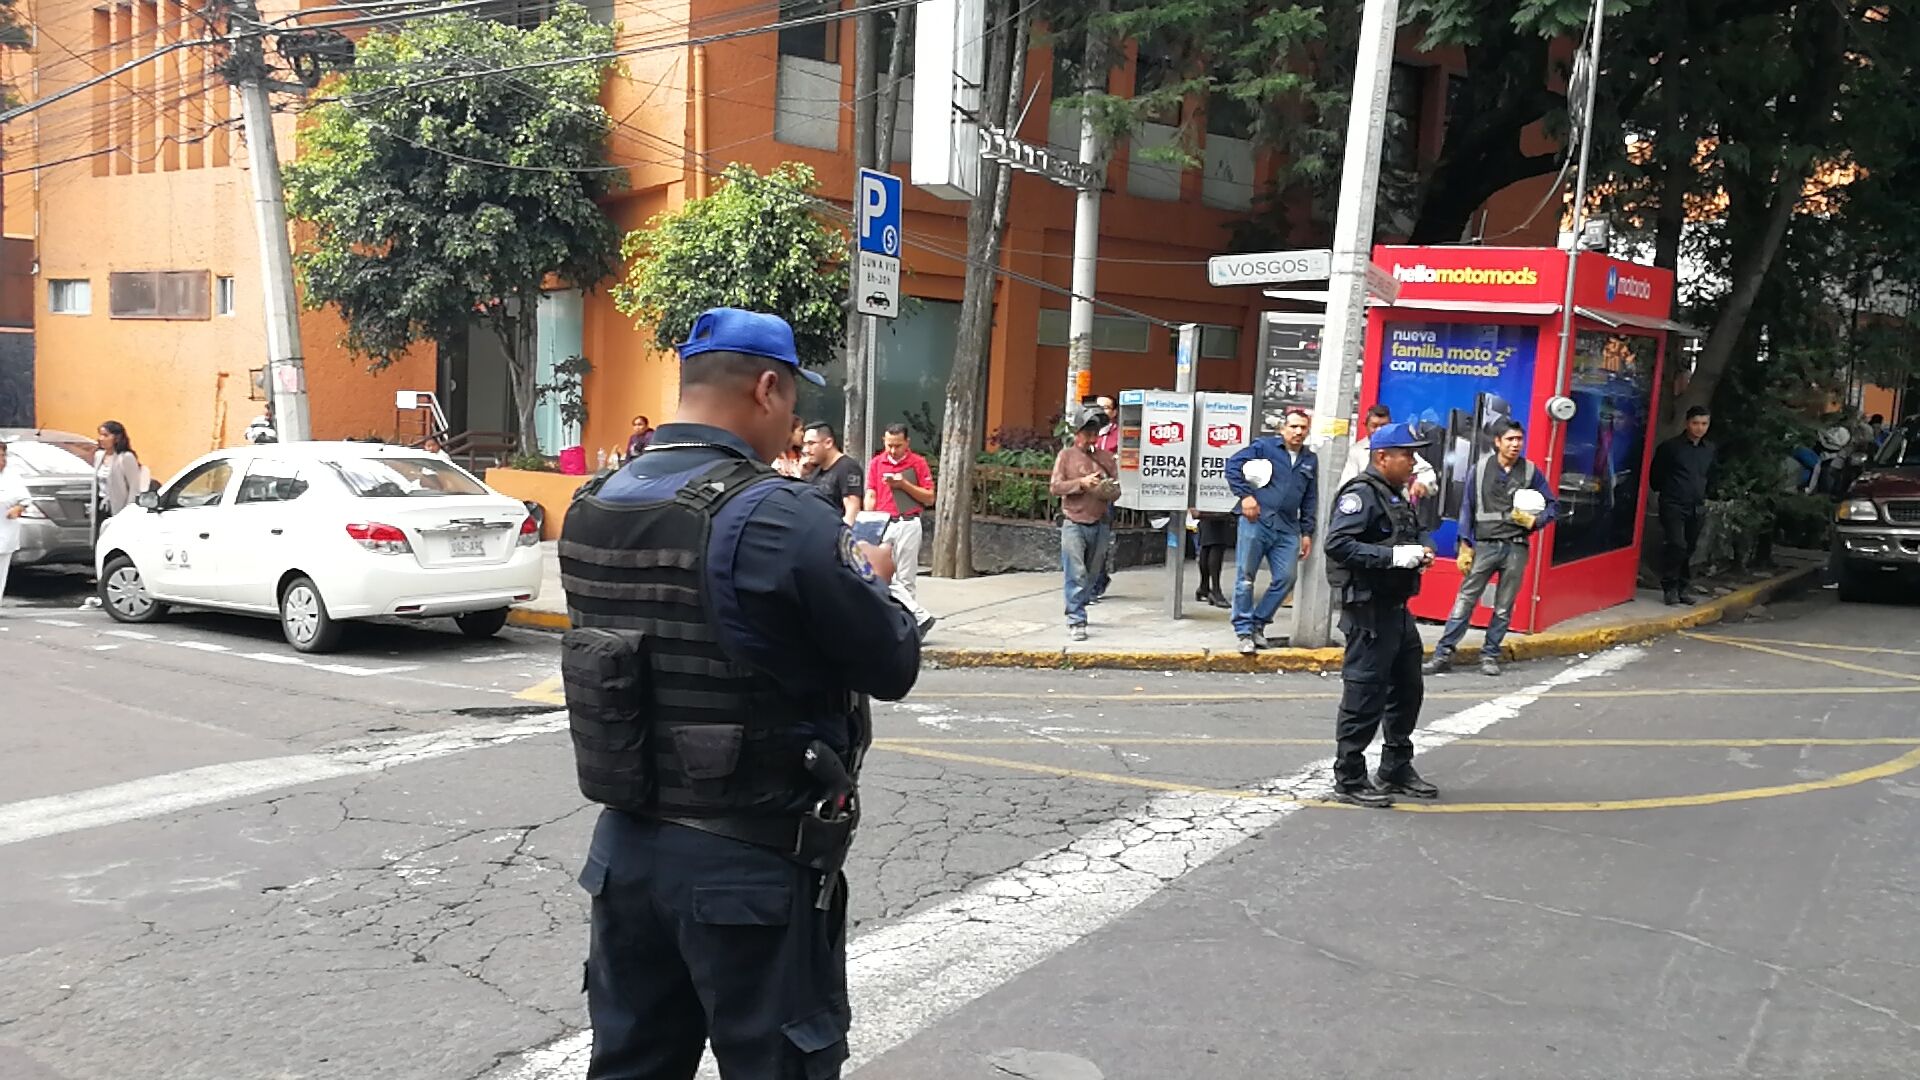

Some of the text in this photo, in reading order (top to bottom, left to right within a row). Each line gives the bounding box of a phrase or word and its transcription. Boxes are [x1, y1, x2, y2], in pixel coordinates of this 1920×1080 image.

[862, 176, 886, 238] P
[1227, 258, 1309, 277] VOSGOS
[1392, 262, 1538, 286] hellomotomods
[1617, 275, 1652, 300] motorola
[1392, 329, 1437, 343] nueva
[1391, 343, 1444, 359] familia
[1447, 346, 1492, 361] moto
[1390, 359, 1417, 373] con
[1146, 400, 1189, 409] infinitum
[1205, 402, 1248, 411] infinitum
[1143, 455, 1187, 468] FIBRA
[1201, 457, 1225, 468] FIB
[1201, 469, 1224, 478] OPT
